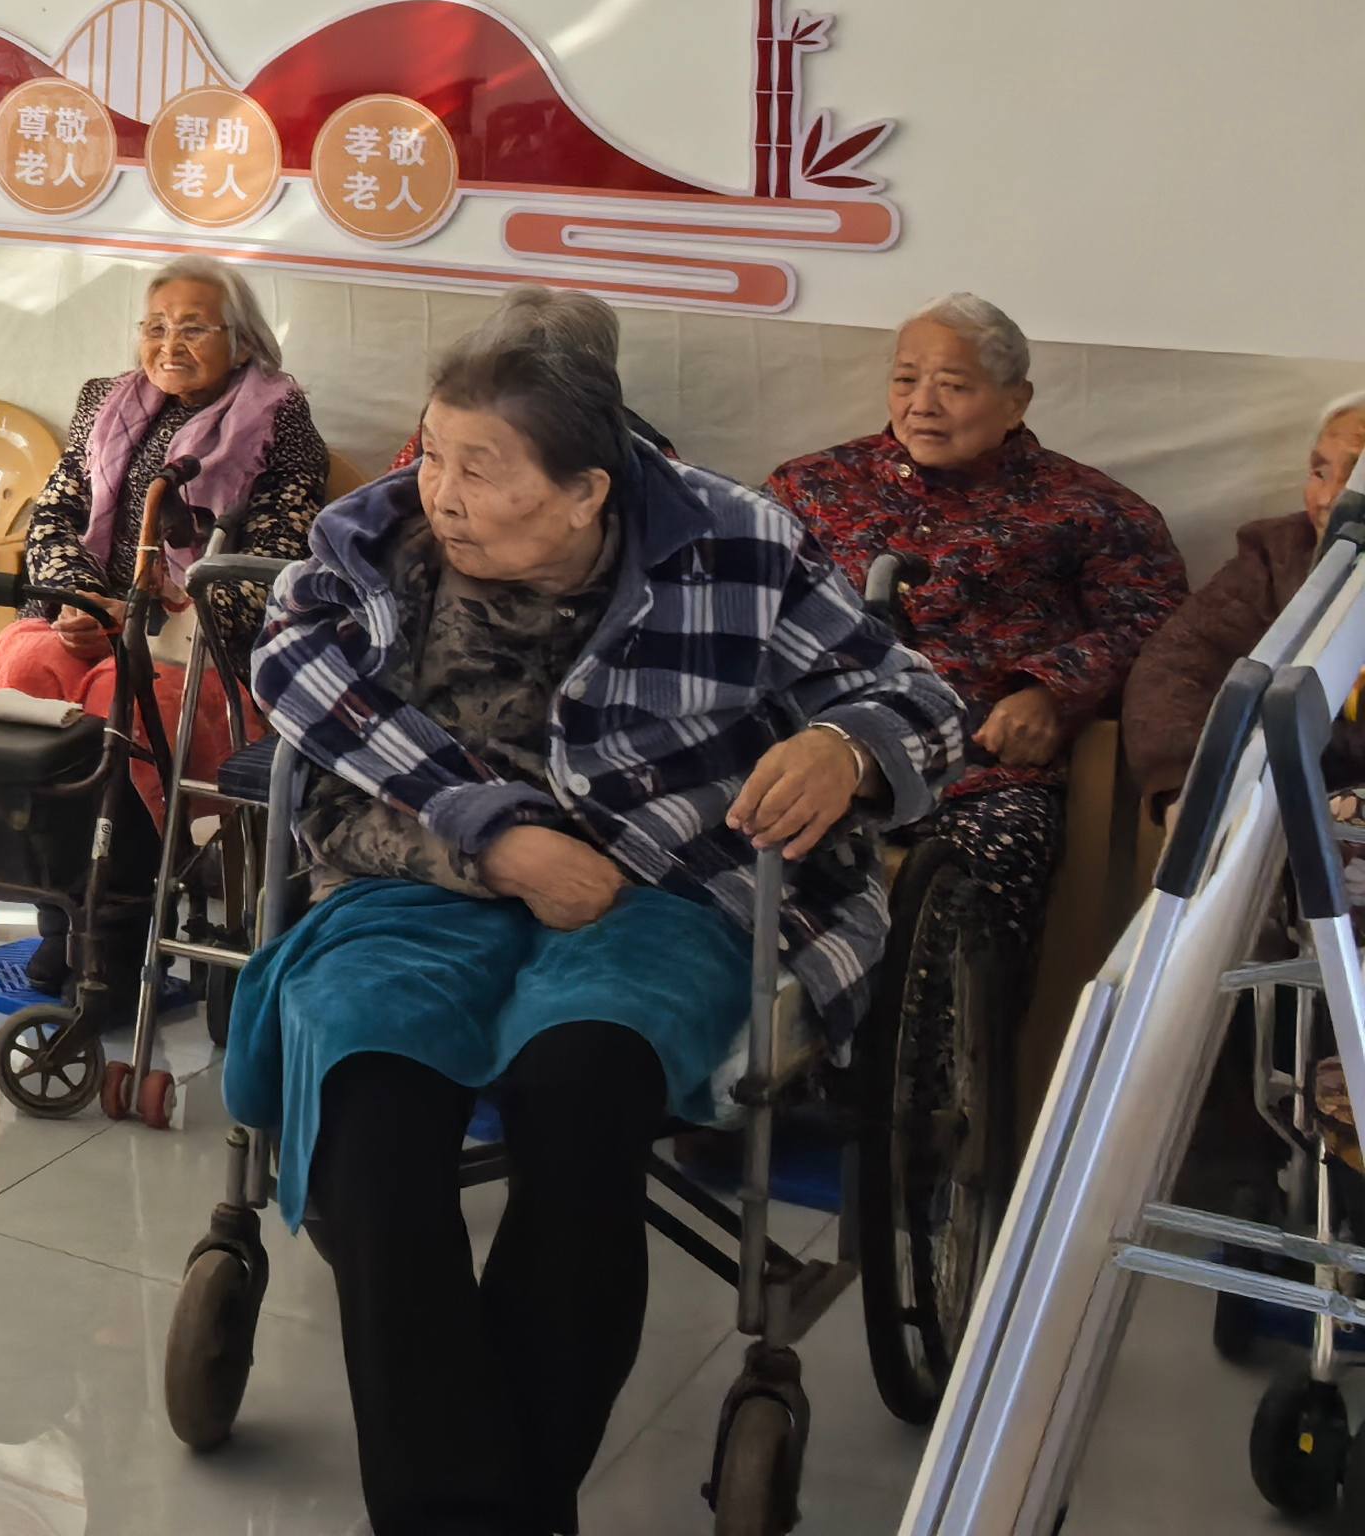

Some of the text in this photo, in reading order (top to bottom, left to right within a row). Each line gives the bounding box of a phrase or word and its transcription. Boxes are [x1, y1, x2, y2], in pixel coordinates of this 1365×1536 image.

[15, 105, 89, 146] 尊敬
[173, 114, 250, 155] 帮助
[343, 124, 428, 168] 孝敬
[14, 149, 87, 189] 老人
[172, 160, 249, 202] 老人
[342, 171, 425, 215] 老人
